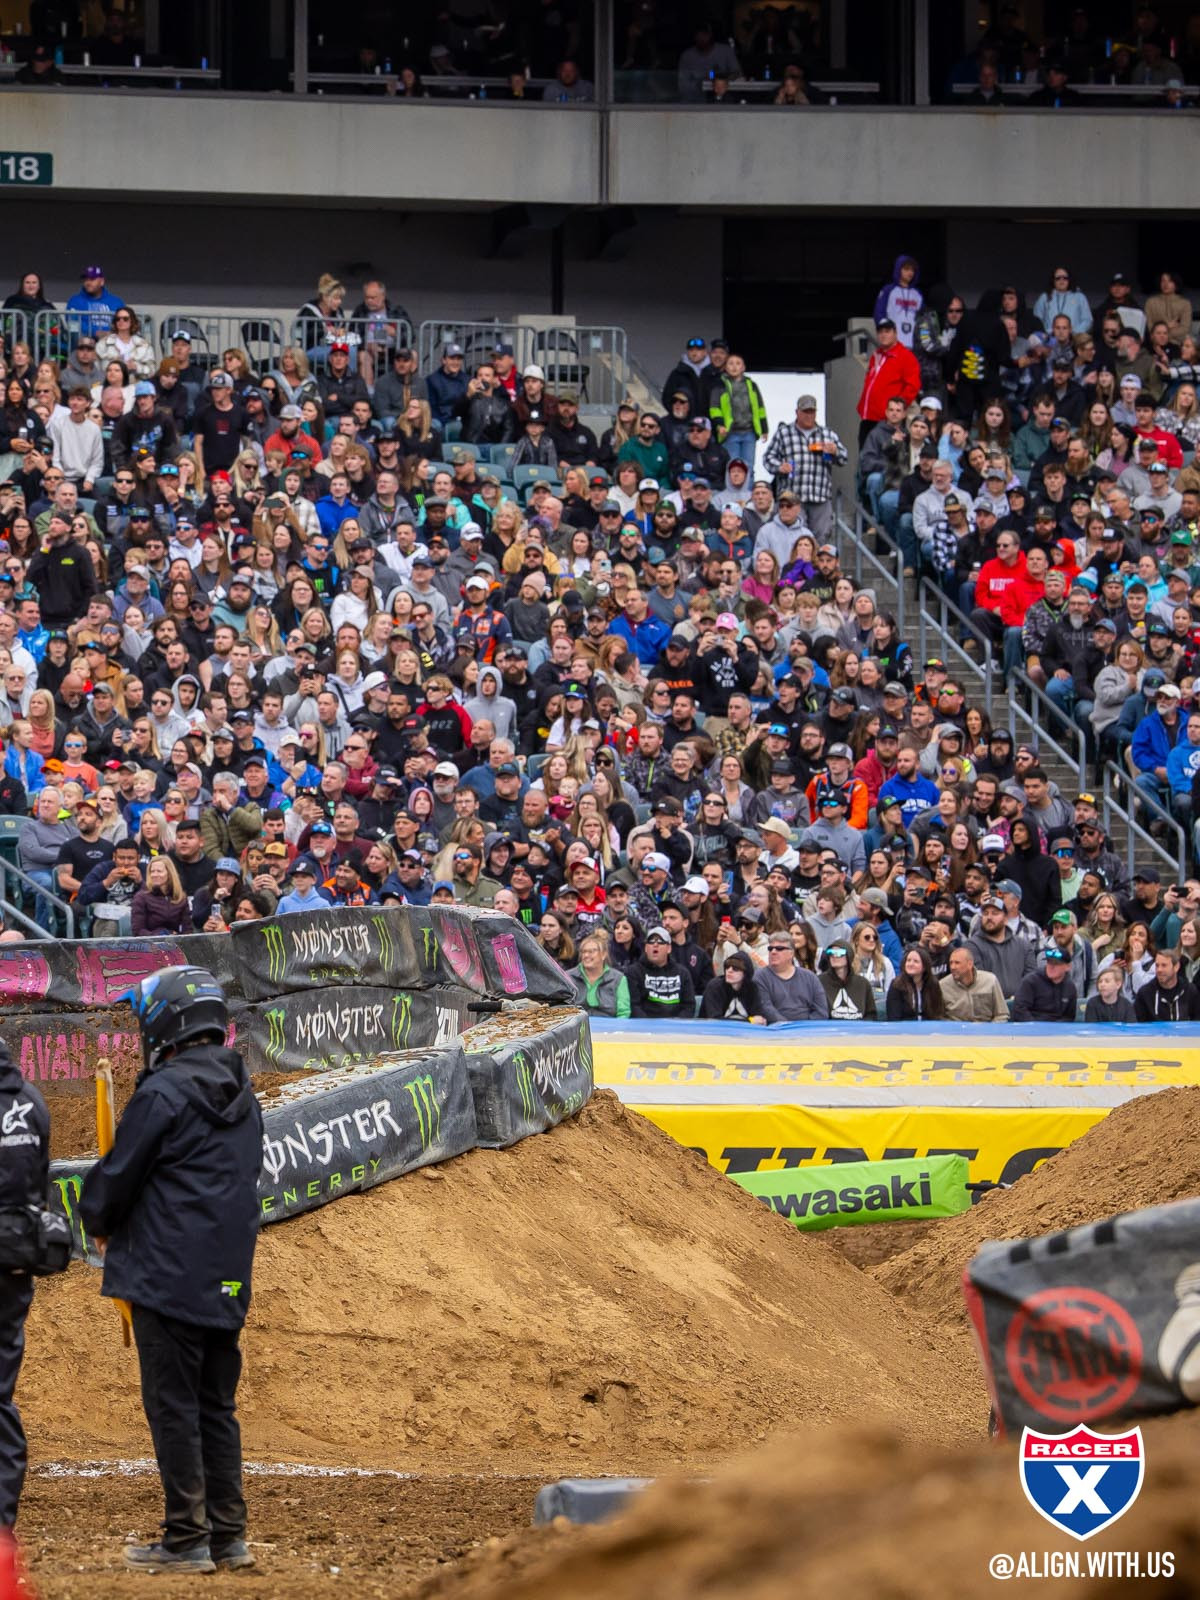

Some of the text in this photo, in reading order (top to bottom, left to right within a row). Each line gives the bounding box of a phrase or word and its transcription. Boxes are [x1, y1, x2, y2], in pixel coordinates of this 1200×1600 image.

[290, 921, 373, 963] MONSTER
[294, 1002, 386, 1050] MONSTER
[259, 1099, 402, 1185] ONSTER
[261, 1158, 382, 1214] ENERGY
